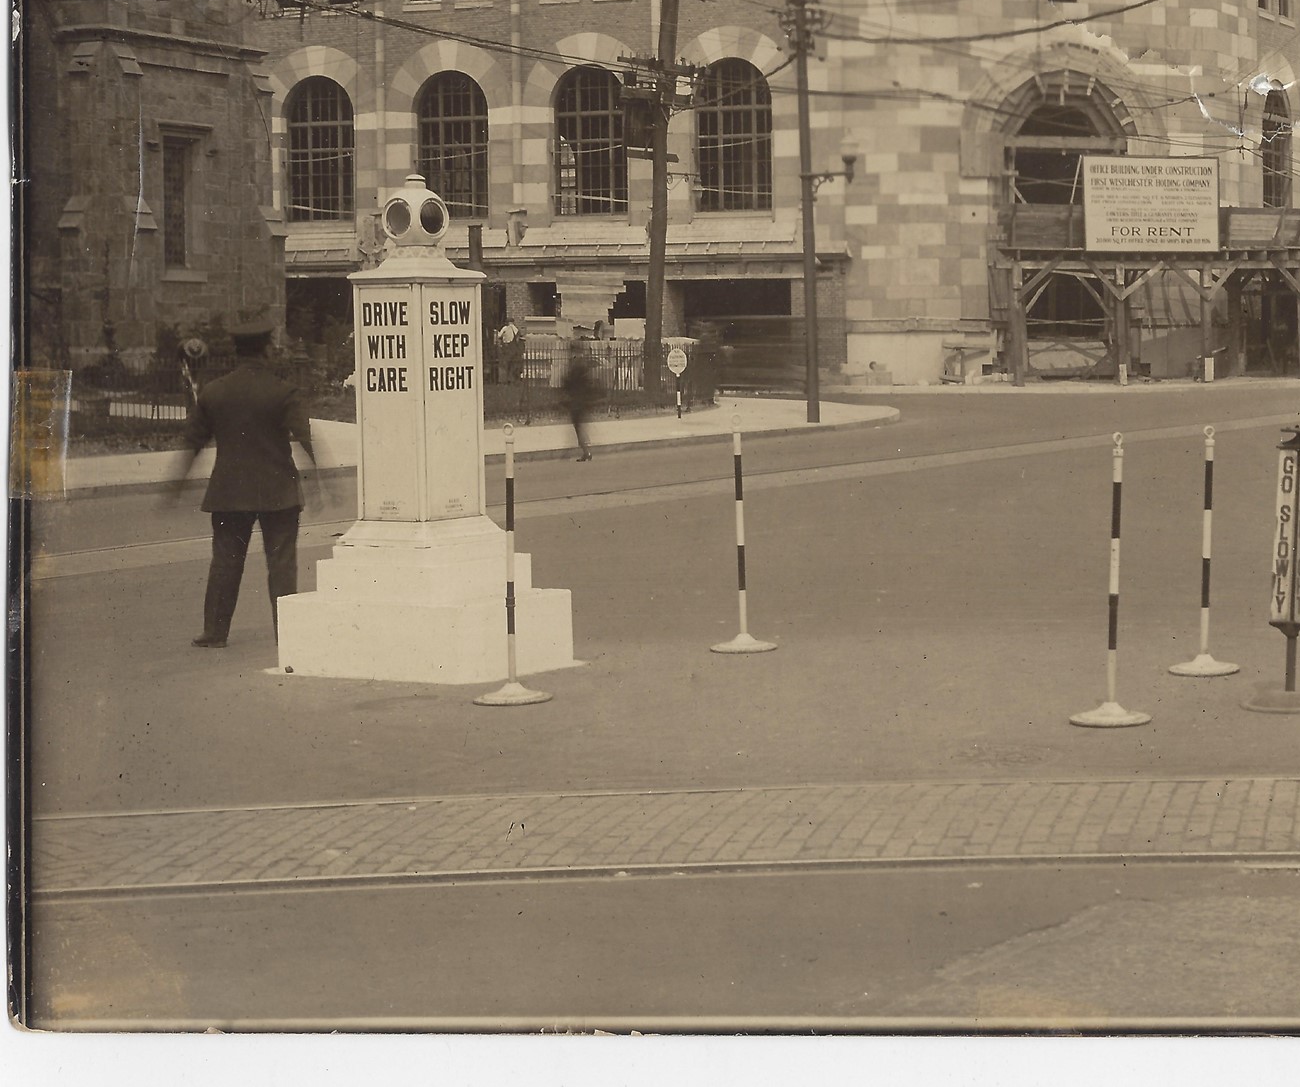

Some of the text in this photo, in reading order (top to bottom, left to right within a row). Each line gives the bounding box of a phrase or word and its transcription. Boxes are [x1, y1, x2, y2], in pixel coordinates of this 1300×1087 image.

[1110, 165, 1140, 174] BUILDING
[1141, 165, 1163, 175] UNDER
[1165, 166, 1212, 176] CONSTRUCTION
[1090, 178, 1210, 188] FIRST WESTCHESTER HOLDING COMPANY
[1111, 226, 1195, 237] FOR RENT
[363, 302, 408, 326] DRIVE
[430, 301, 471, 325] SLOW
[367, 335, 406, 359] WITH
[433, 334, 469, 358] KEEP
[367, 367, 408, 392] CARE
[429, 366, 474, 391] RIGHT
[1275, 456, 1294, 613] GO SLOWLY
